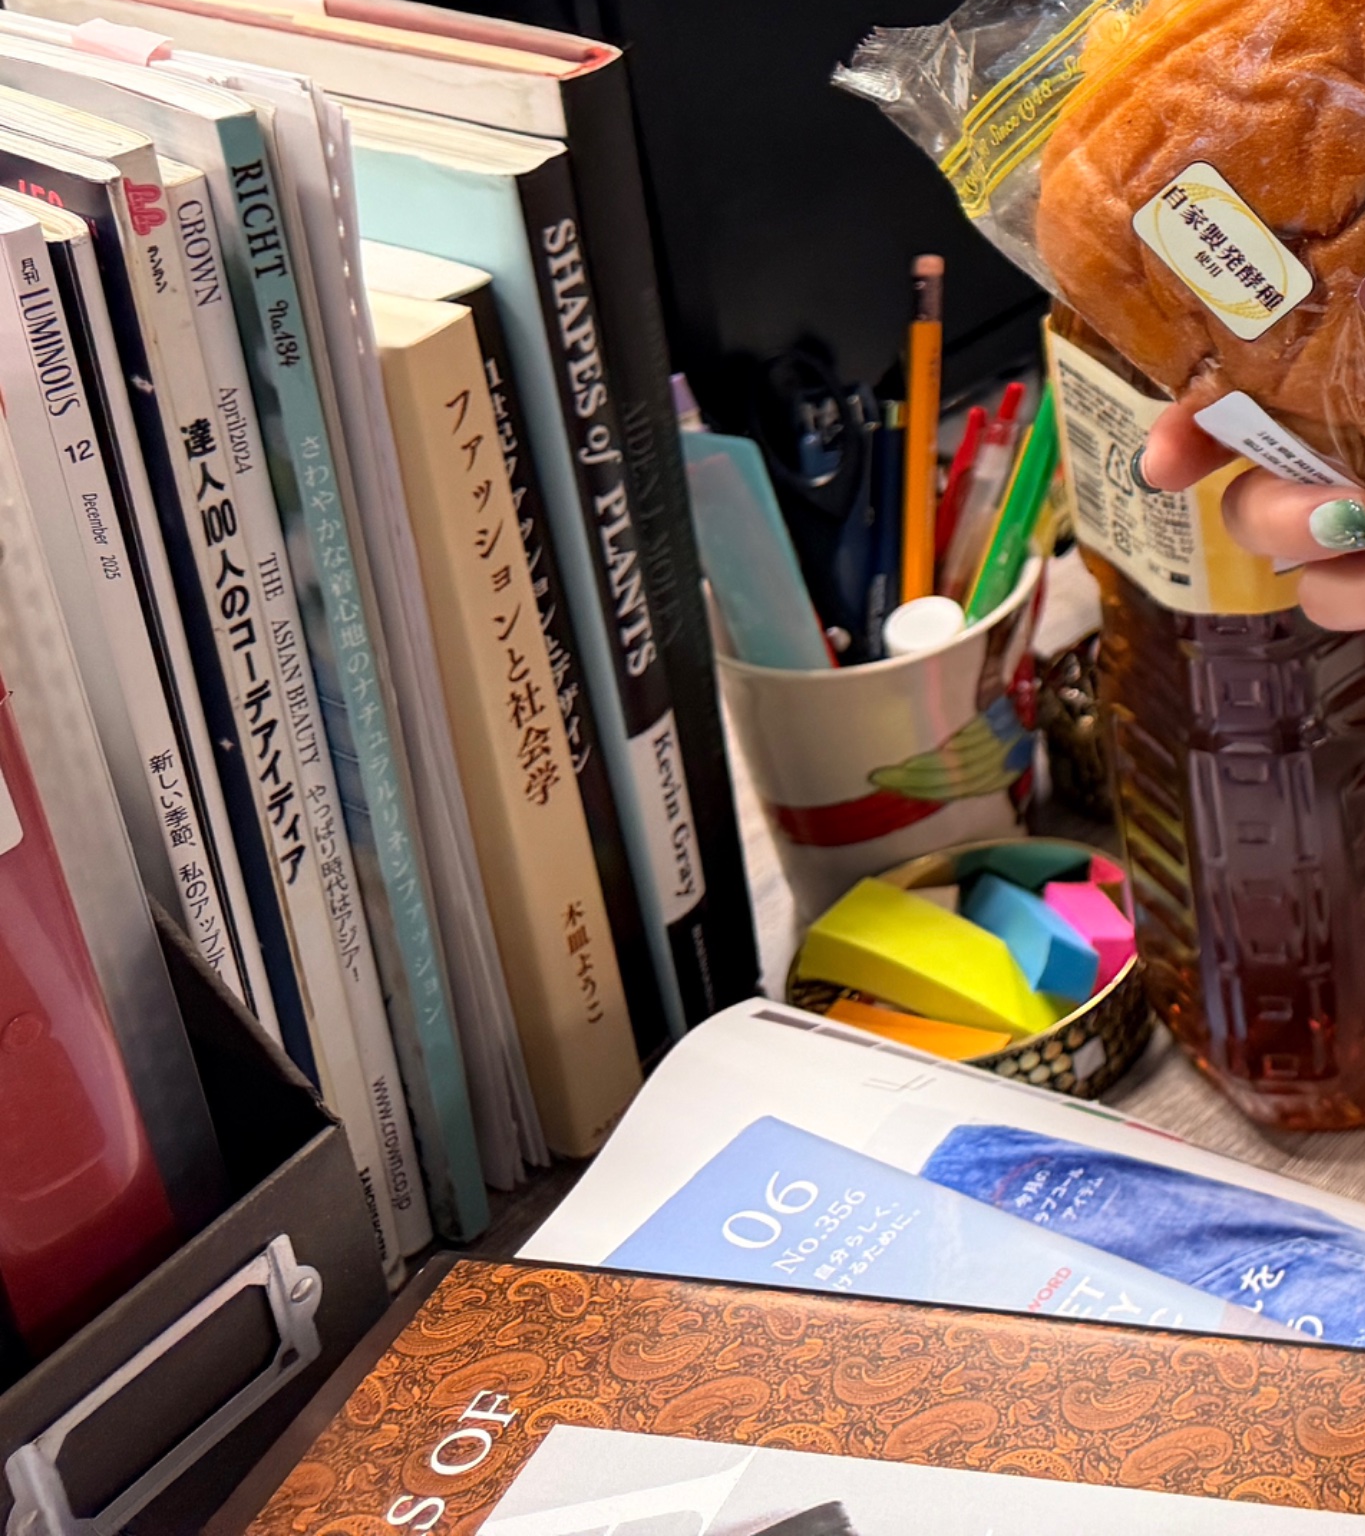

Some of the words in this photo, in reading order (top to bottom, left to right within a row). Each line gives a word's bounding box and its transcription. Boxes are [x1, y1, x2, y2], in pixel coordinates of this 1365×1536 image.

[177, 199, 223, 308] CROWN
[231, 160, 288, 280] RICHT
[1158, 183, 1287, 314] 自家製発酵種
[1193, 249, 1224, 281] 使用
[18, 286, 81, 417] LUMINOUS
[543, 218, 608, 419] SHAPES
[63, 439, 95, 465] 12
[218, 386, 254, 476] April2024
[578, 427, 623, 466] of
[81, 492, 110, 547] December
[99, 553, 122, 581] 2025
[257, 552, 285, 602] THE
[594, 482, 659, 680] PLANTS
[444, 388, 562, 808] ファッションと社会学
[179, 416, 309, 887] 達人100人のコーデアイディア
[270, 619, 301, 683] ASIAN
[286, 683, 322, 768] BEAUTY
[652, 730, 682, 822] Kevin
[671, 822, 699, 900] Gray
[721, 1170, 819, 1250] 06
[770, 1187, 867, 1275] No.356
[387, 1495, 445, 1536] S
[430, 1390, 521, 1476] OF
